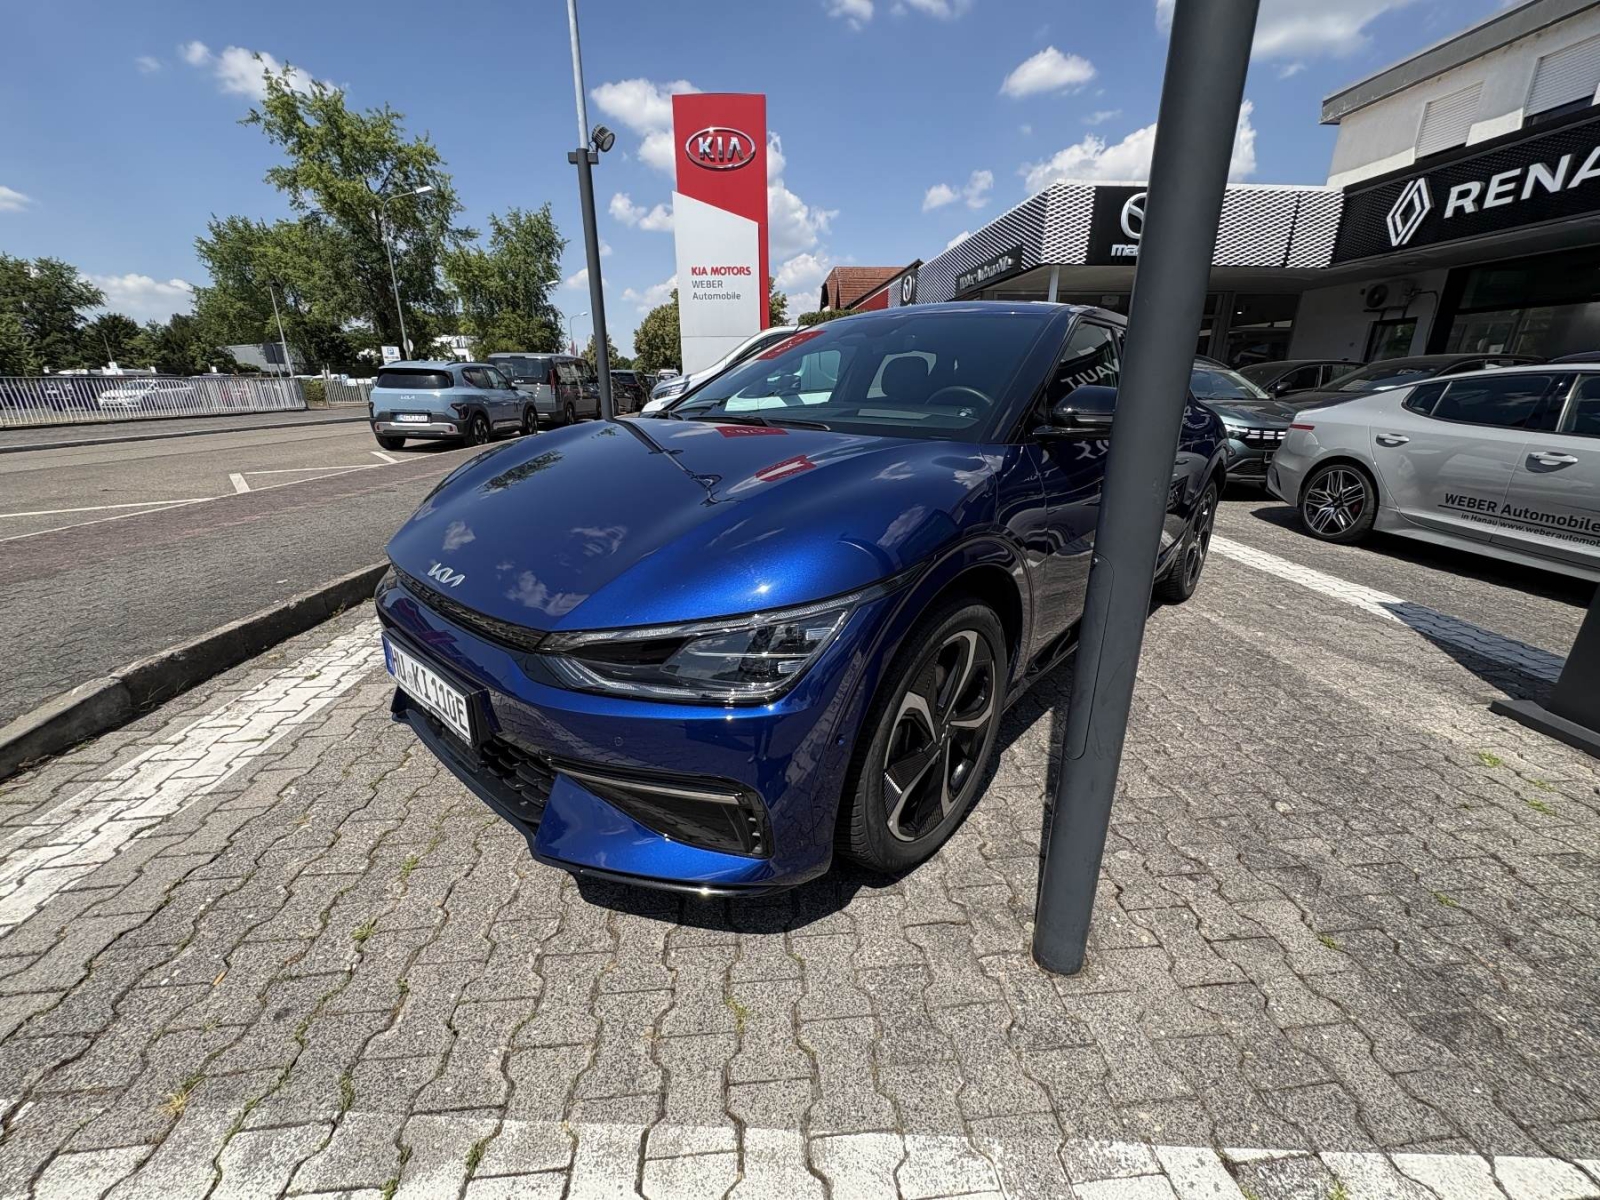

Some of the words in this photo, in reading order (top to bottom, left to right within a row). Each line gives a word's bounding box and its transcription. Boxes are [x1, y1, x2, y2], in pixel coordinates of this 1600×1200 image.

[698, 136, 744, 162] KIA
[691, 266, 707, 276] KIA
[710, 266, 751, 276] MOTORS
[692, 280, 723, 289] WEBER
[692, 291, 741, 301] Automobile
[1445, 493, 1497, 513] WEBER
[1500, 504, 1600, 532] Automobile
[1470, 514, 1498, 526] Hanau
